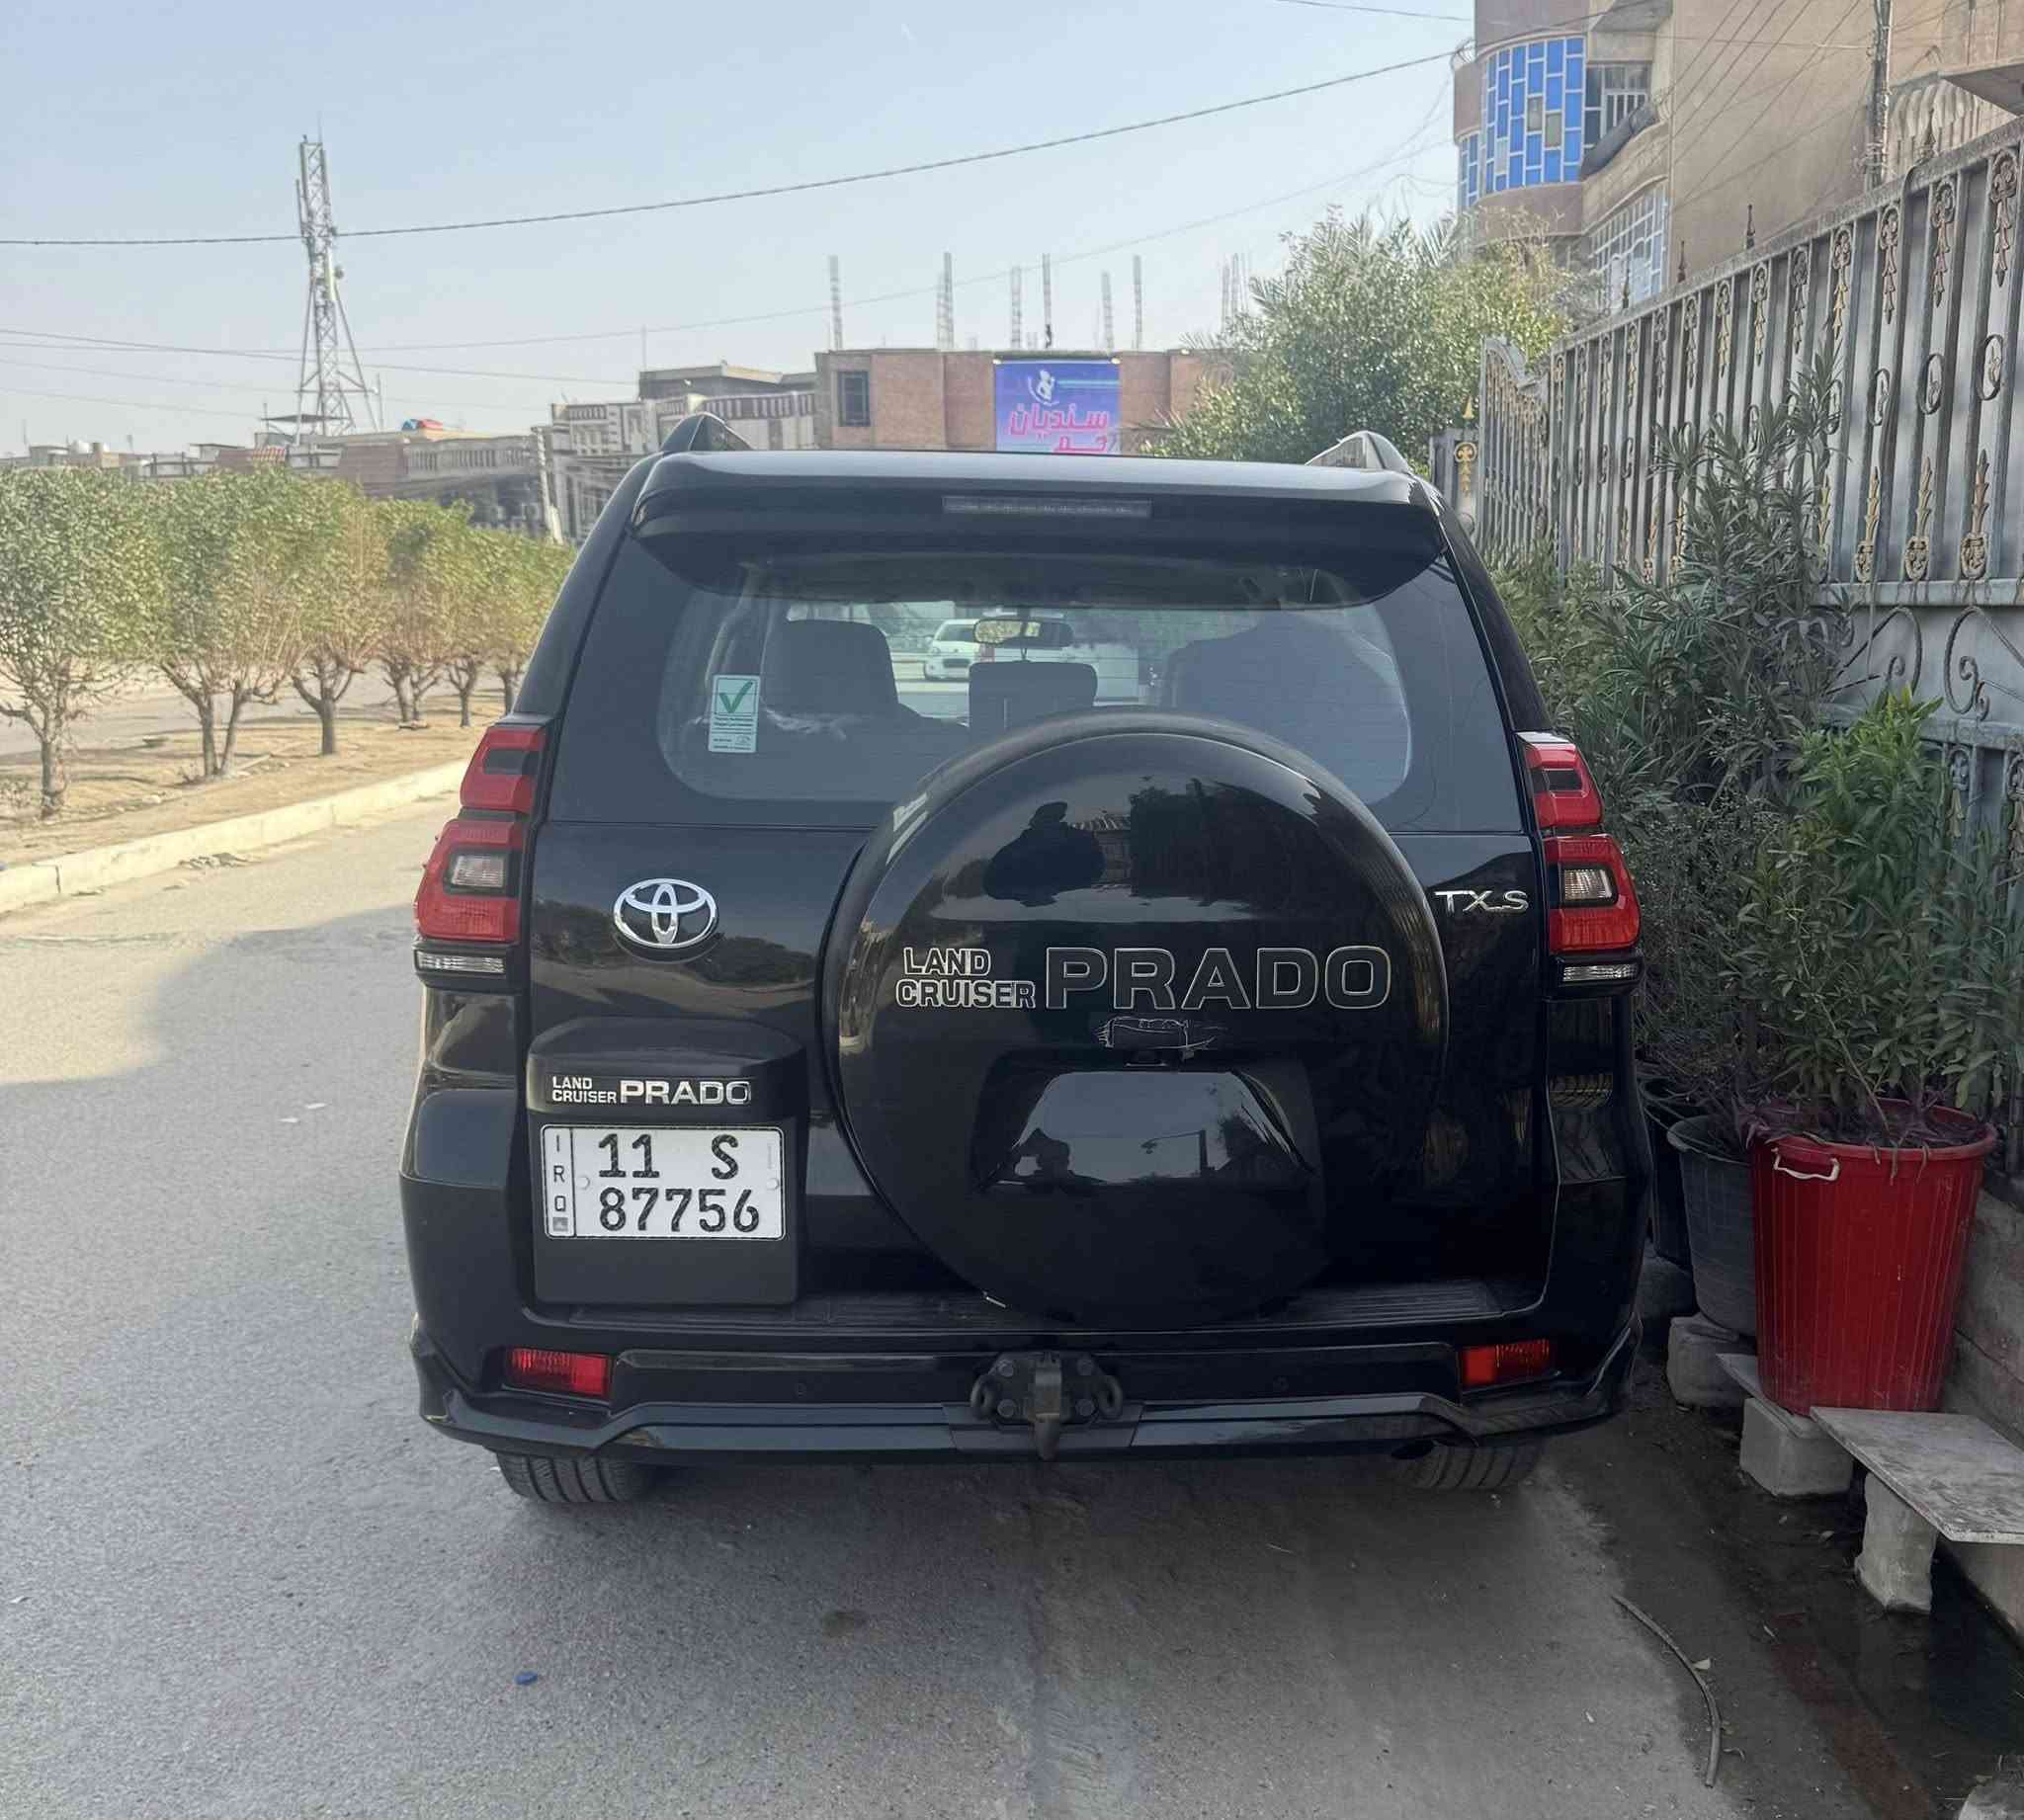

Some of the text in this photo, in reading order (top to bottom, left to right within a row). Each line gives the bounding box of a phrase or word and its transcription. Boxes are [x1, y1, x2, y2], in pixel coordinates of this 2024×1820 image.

[903, 947, 992, 977] LAND
[1046, 946, 1392, 1010] PRADO
[895, 979, 1036, 1009] CRUISER
[552, 1076, 592, 1090] LAND
[552, 1090, 617, 1104] CRUISER
[620, 1080, 752, 1106] PRADO
[598, 1133, 660, 1178] 11
[711, 1134, 738, 1180] S
[599, 1187, 760, 1233] 87756
